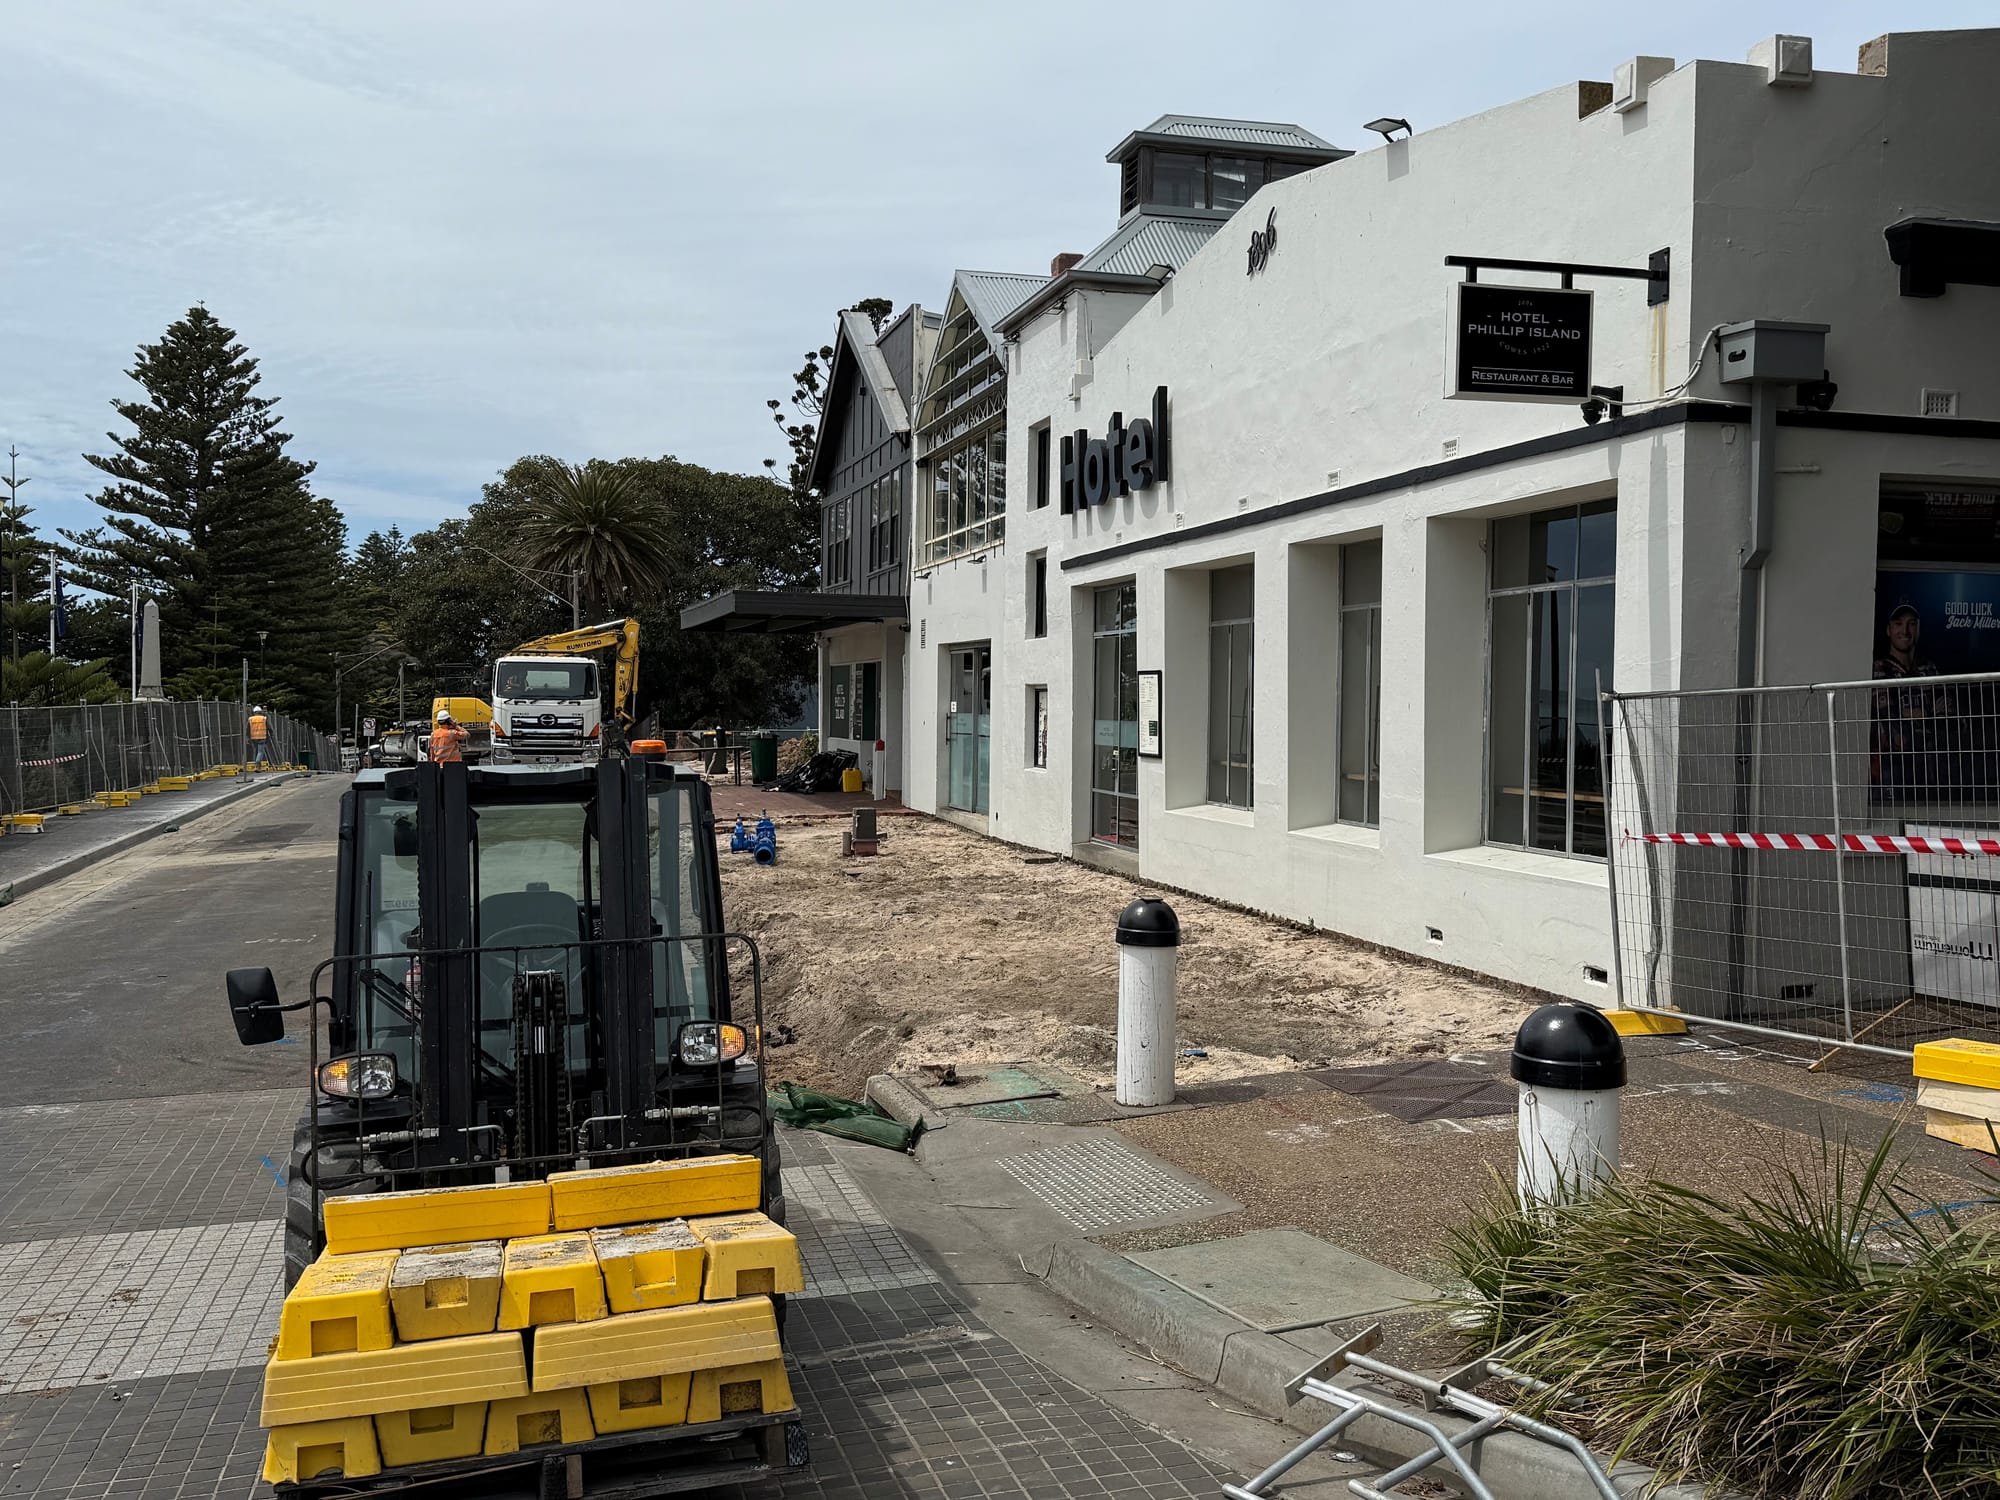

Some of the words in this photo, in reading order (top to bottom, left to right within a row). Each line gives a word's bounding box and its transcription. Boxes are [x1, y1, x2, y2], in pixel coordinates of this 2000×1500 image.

[1501, 312, 1550, 324] HOTEL
[1468, 324, 1524, 336] PHILLIP
[1529, 328, 1581, 340] ISLAND
[1472, 371, 1539, 383] RESTAURANT
[1541, 375, 1550, 383] &
[1552, 375, 1574, 385] BAR
[1060, 386, 1168, 515] Hotel
[1945, 601, 1968, 615] GOOD
[1971, 602, 1993, 616] LUCK
[1946, 616, 1971, 629] Jack
[1973, 616, 2000, 629] Miller
[566, 639, 602, 650] SUMITOMO
